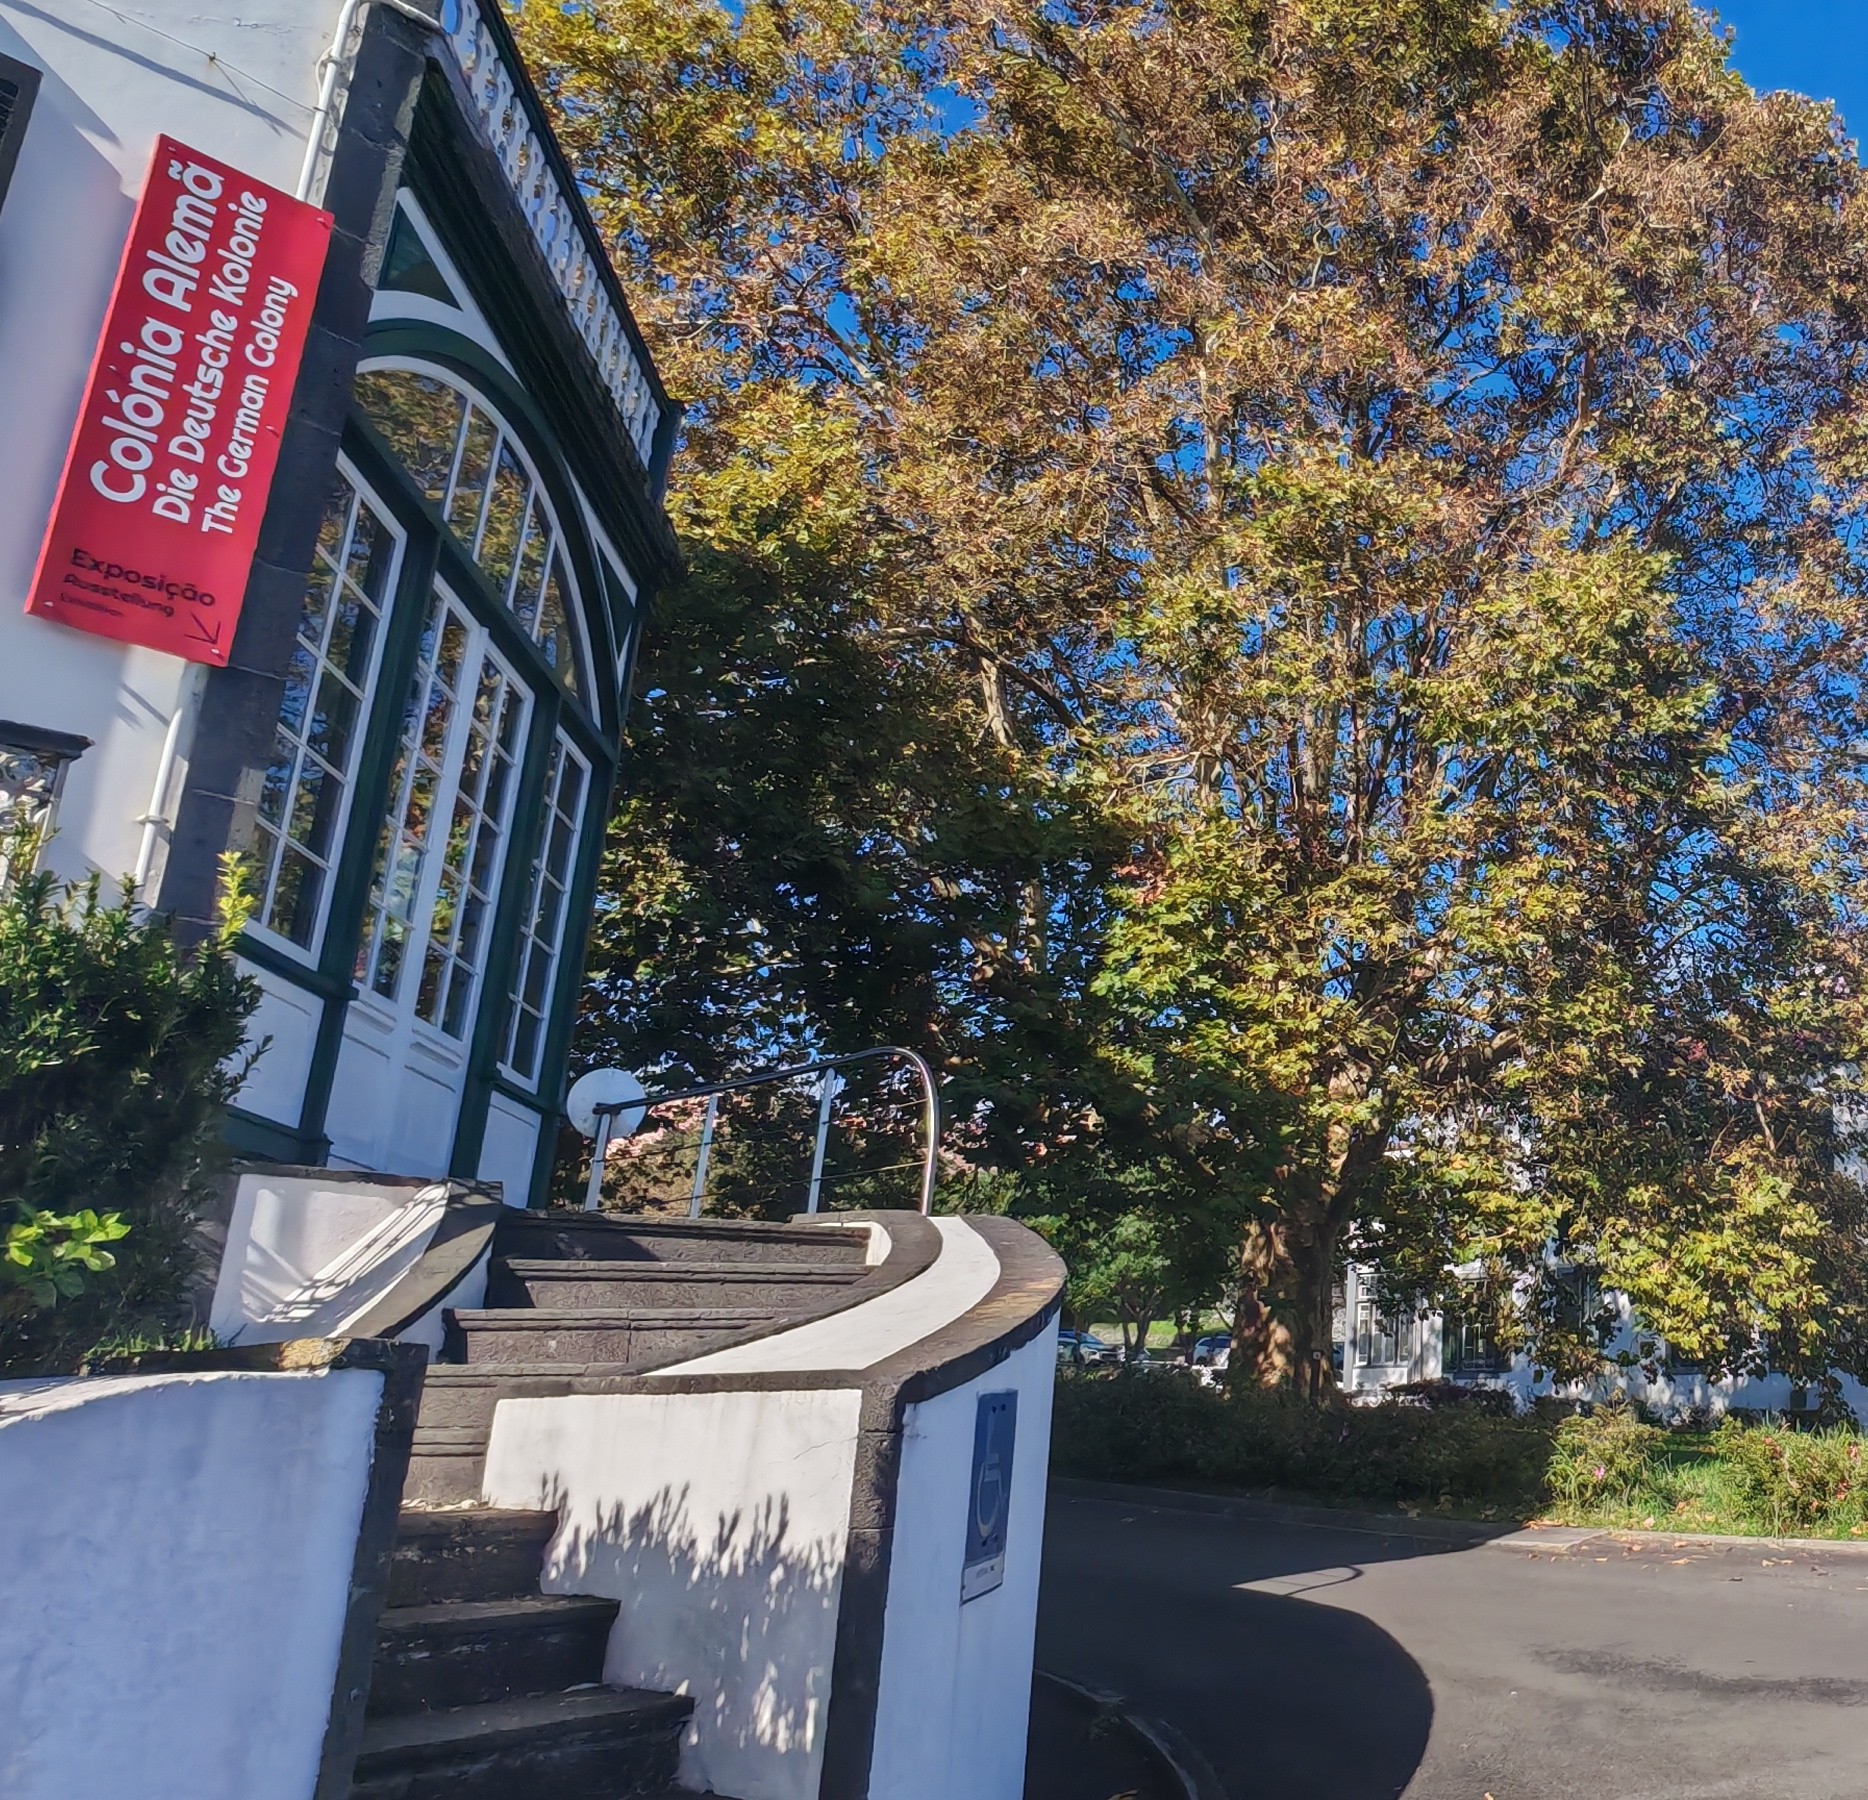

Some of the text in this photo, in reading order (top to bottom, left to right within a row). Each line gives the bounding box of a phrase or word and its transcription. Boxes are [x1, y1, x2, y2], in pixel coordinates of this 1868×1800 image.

[90, 316, 185, 503] Colónia
[142, 159, 225, 312] Alemã
[153, 191, 267, 524] Die Deutsche Kolonie
[201, 275, 299, 534] The German Colony
[71, 548, 216, 606] Exposição
